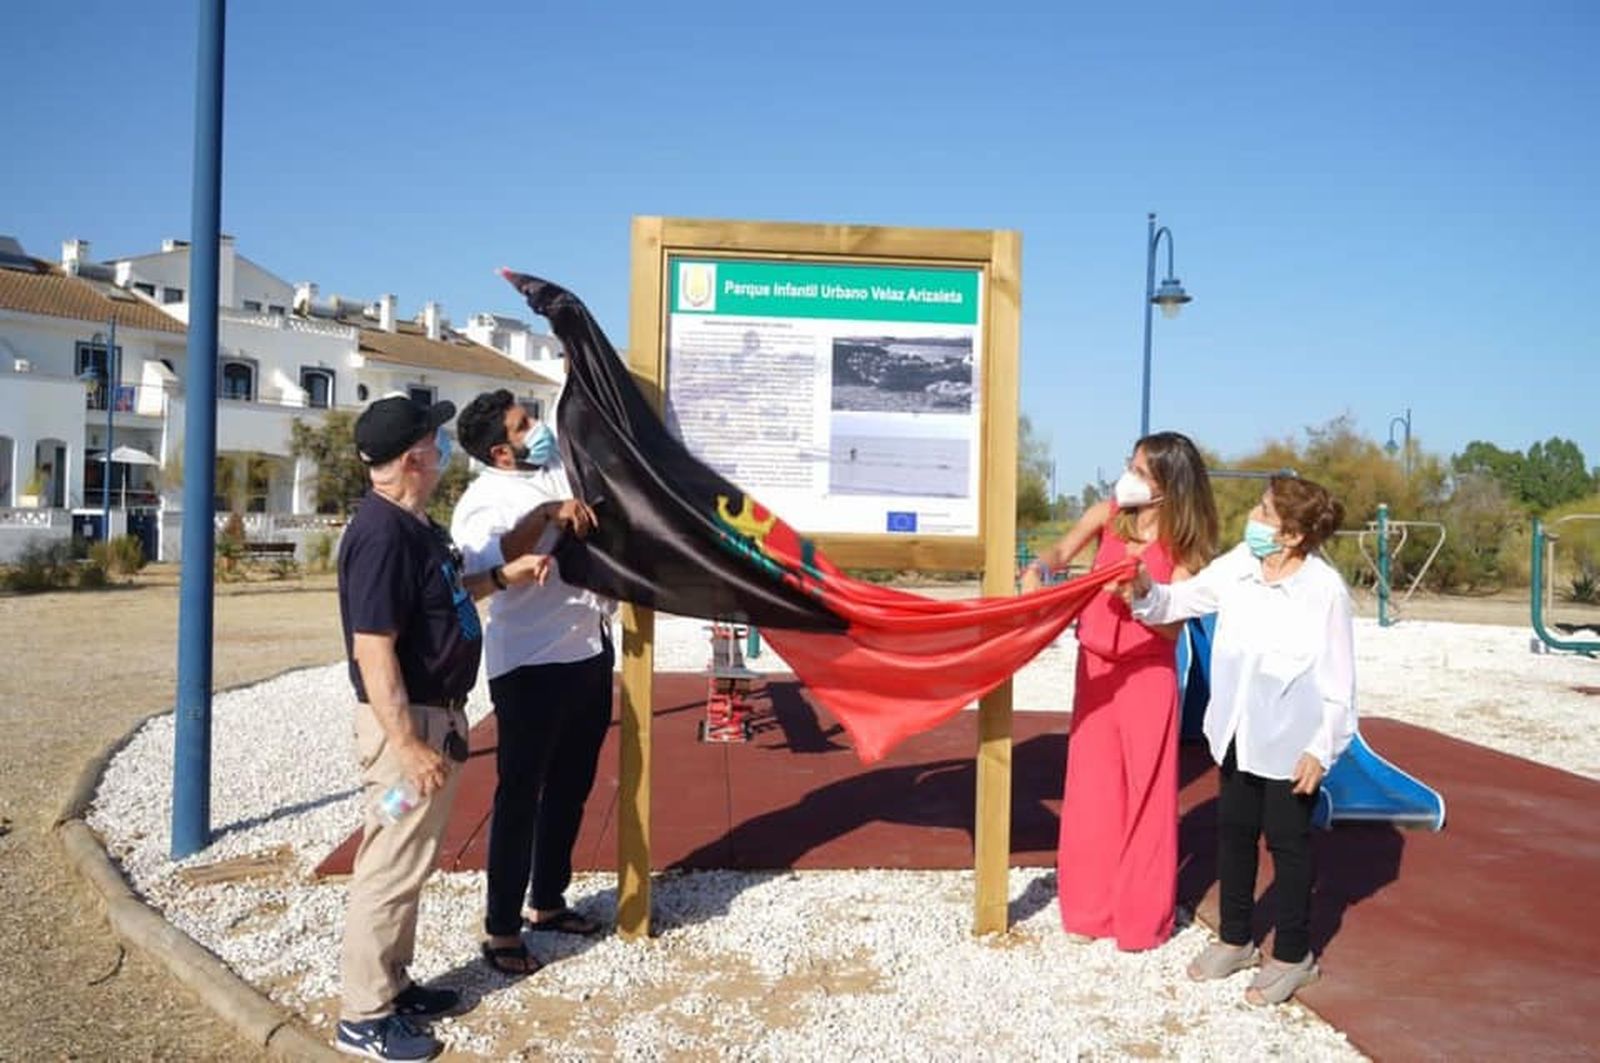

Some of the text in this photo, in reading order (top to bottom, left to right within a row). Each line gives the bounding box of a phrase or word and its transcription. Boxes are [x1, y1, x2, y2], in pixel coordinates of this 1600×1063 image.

[724, 280, 770, 299] Parque
[774, 281, 817, 298] Infantil
[821, 284, 868, 299] Urbano
